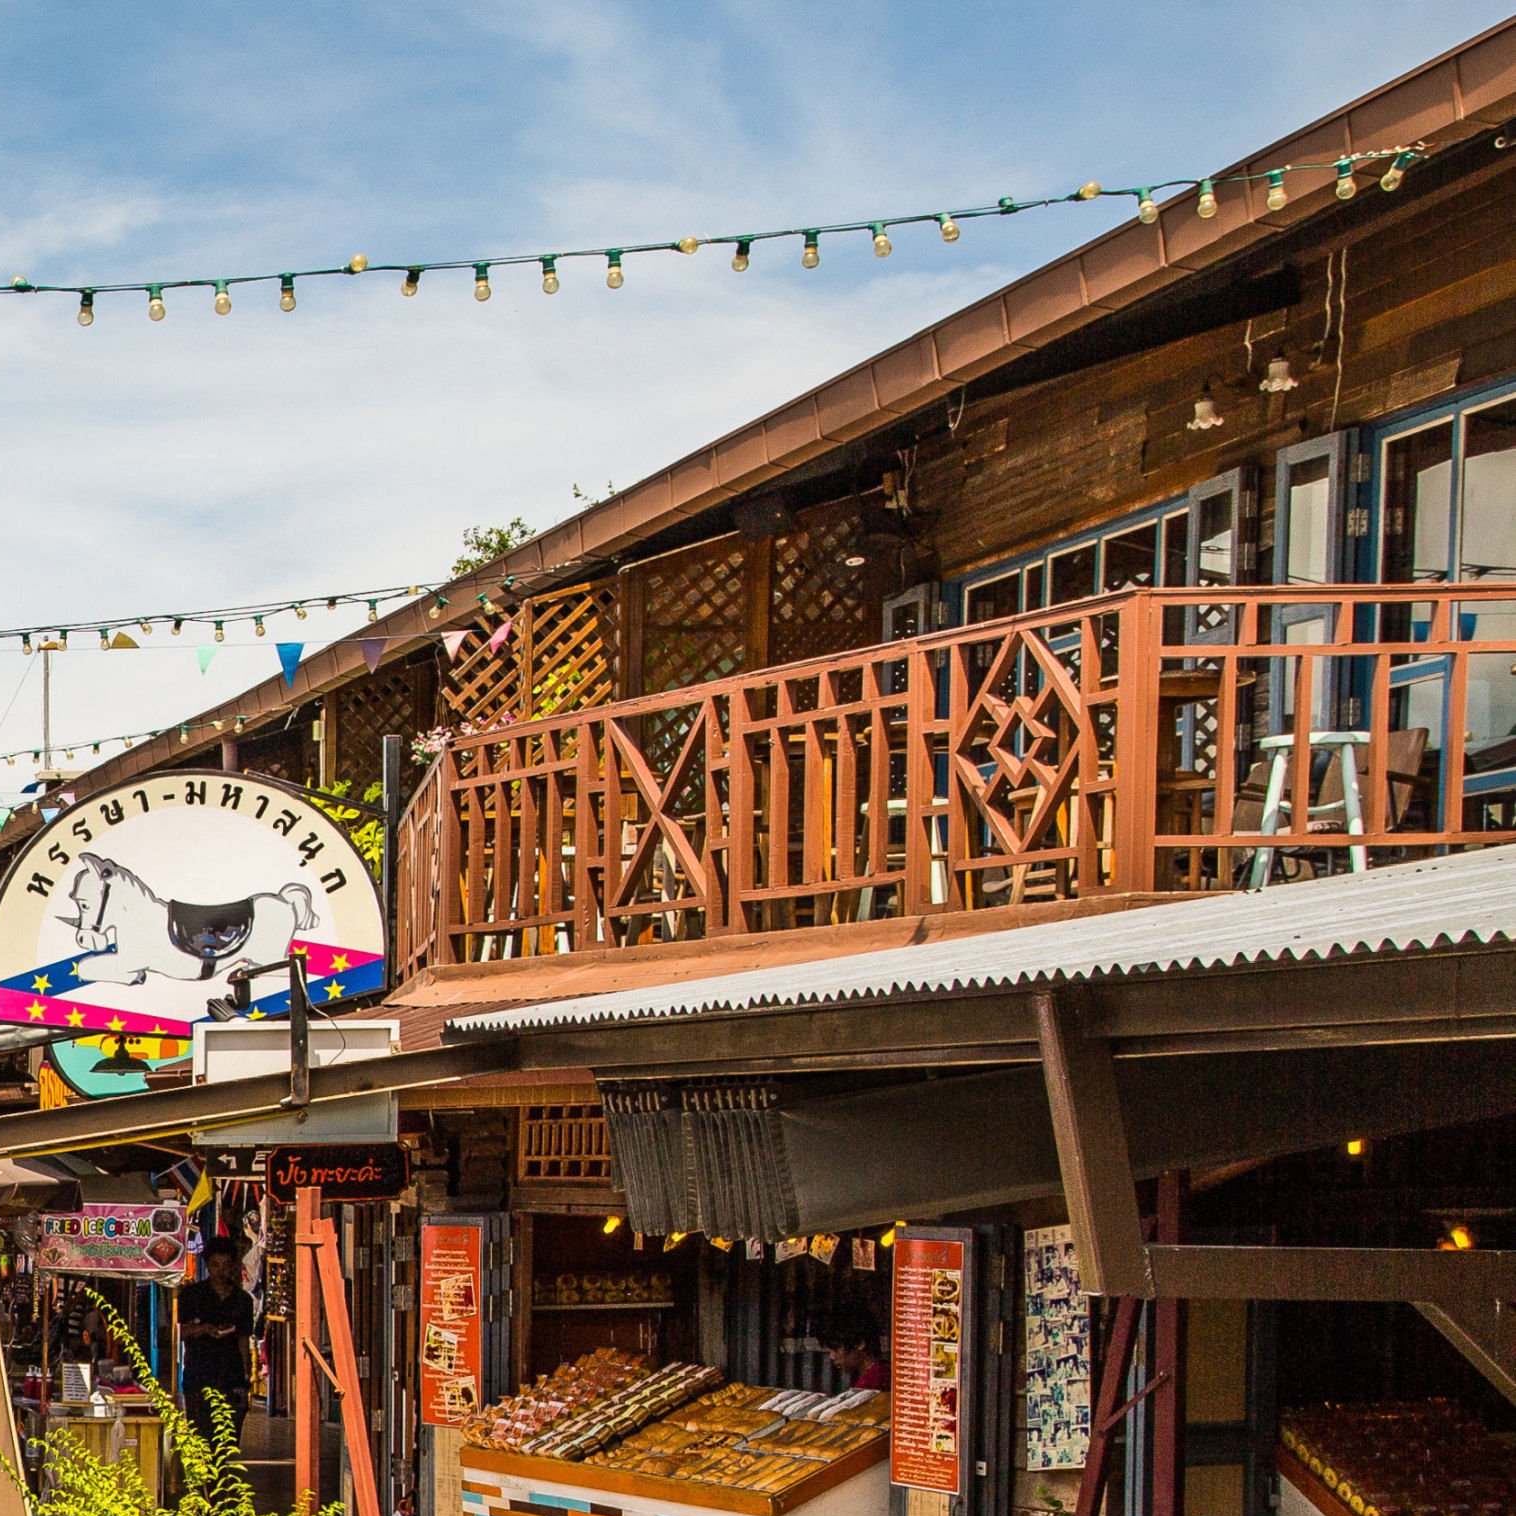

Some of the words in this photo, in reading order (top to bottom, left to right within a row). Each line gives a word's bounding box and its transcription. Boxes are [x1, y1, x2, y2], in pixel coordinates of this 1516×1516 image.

[25, 778, 348, 898] หรรษา-มหาสนุก
[45, 1217, 81, 1236] FRIED
